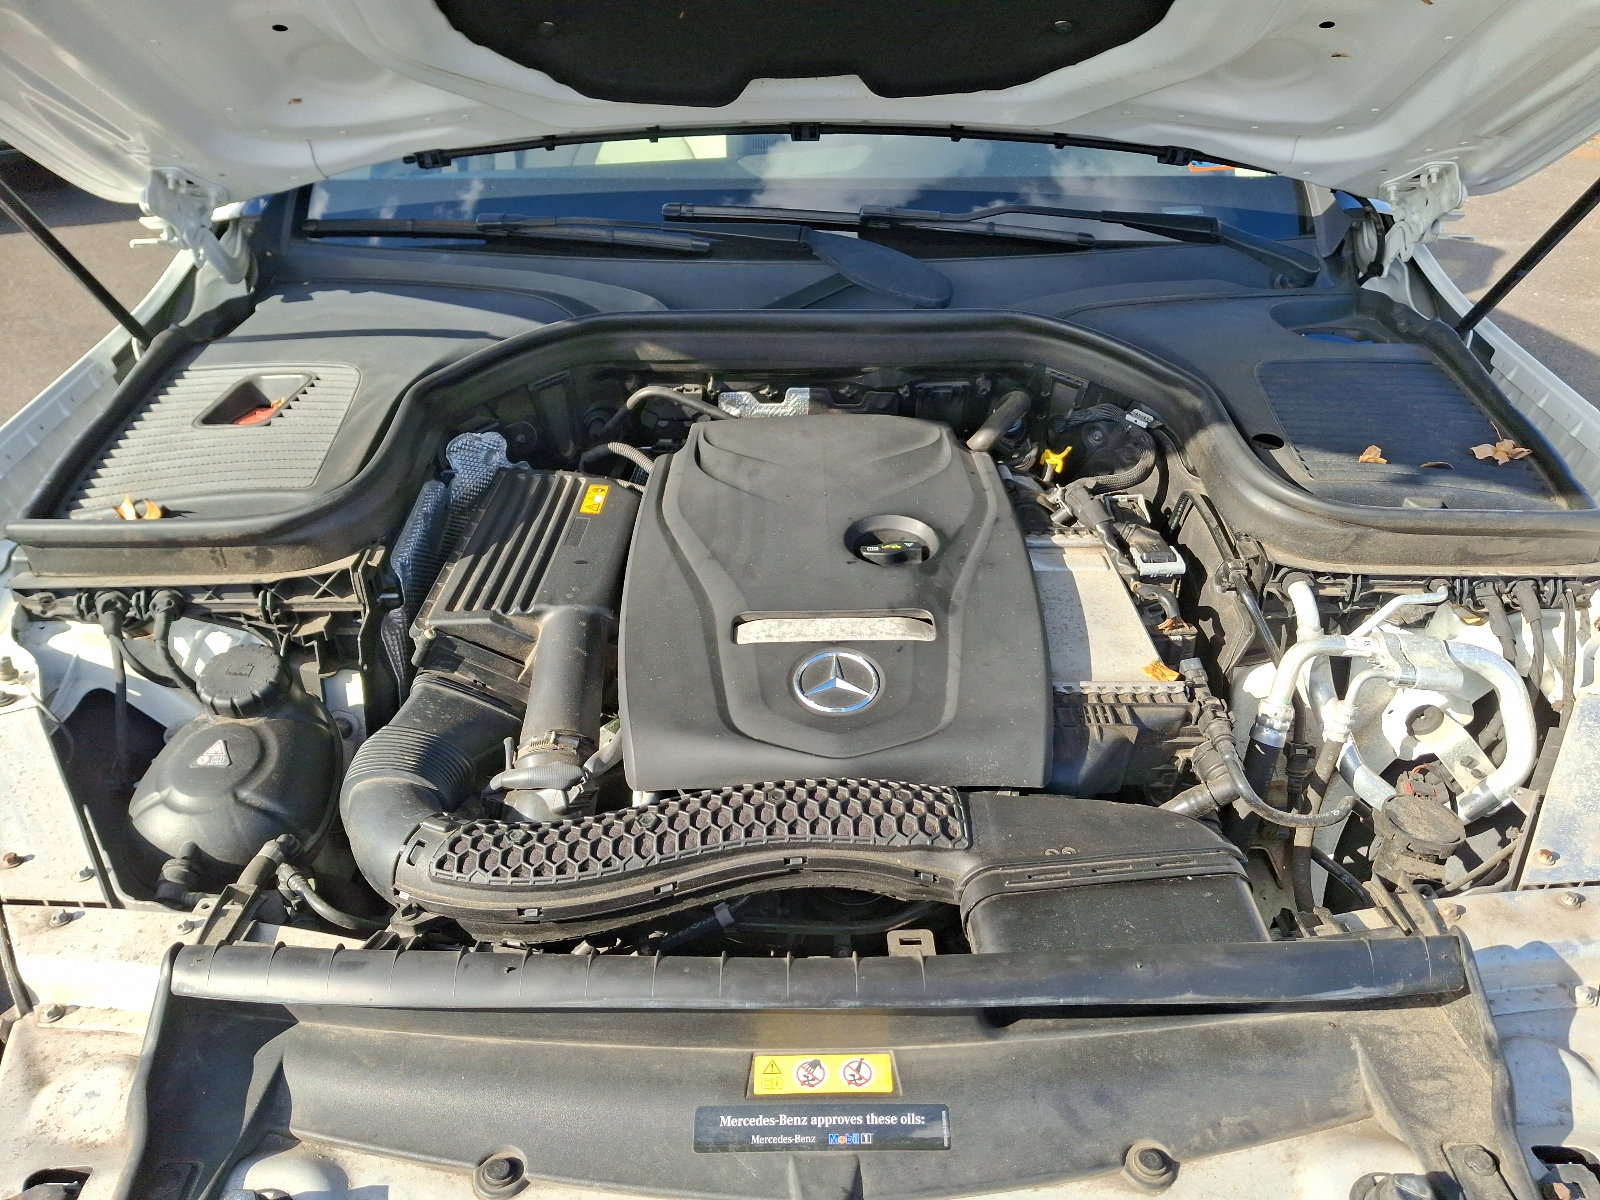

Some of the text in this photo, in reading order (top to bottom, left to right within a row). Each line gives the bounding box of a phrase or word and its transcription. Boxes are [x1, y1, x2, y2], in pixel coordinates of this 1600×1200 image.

[720, 1112, 925, 1128] Mercedes-Benz approves these oils:
[751, 1134, 816, 1144] Mercedes-Benz
[829, 1133, 873, 1145] Mobil 1
